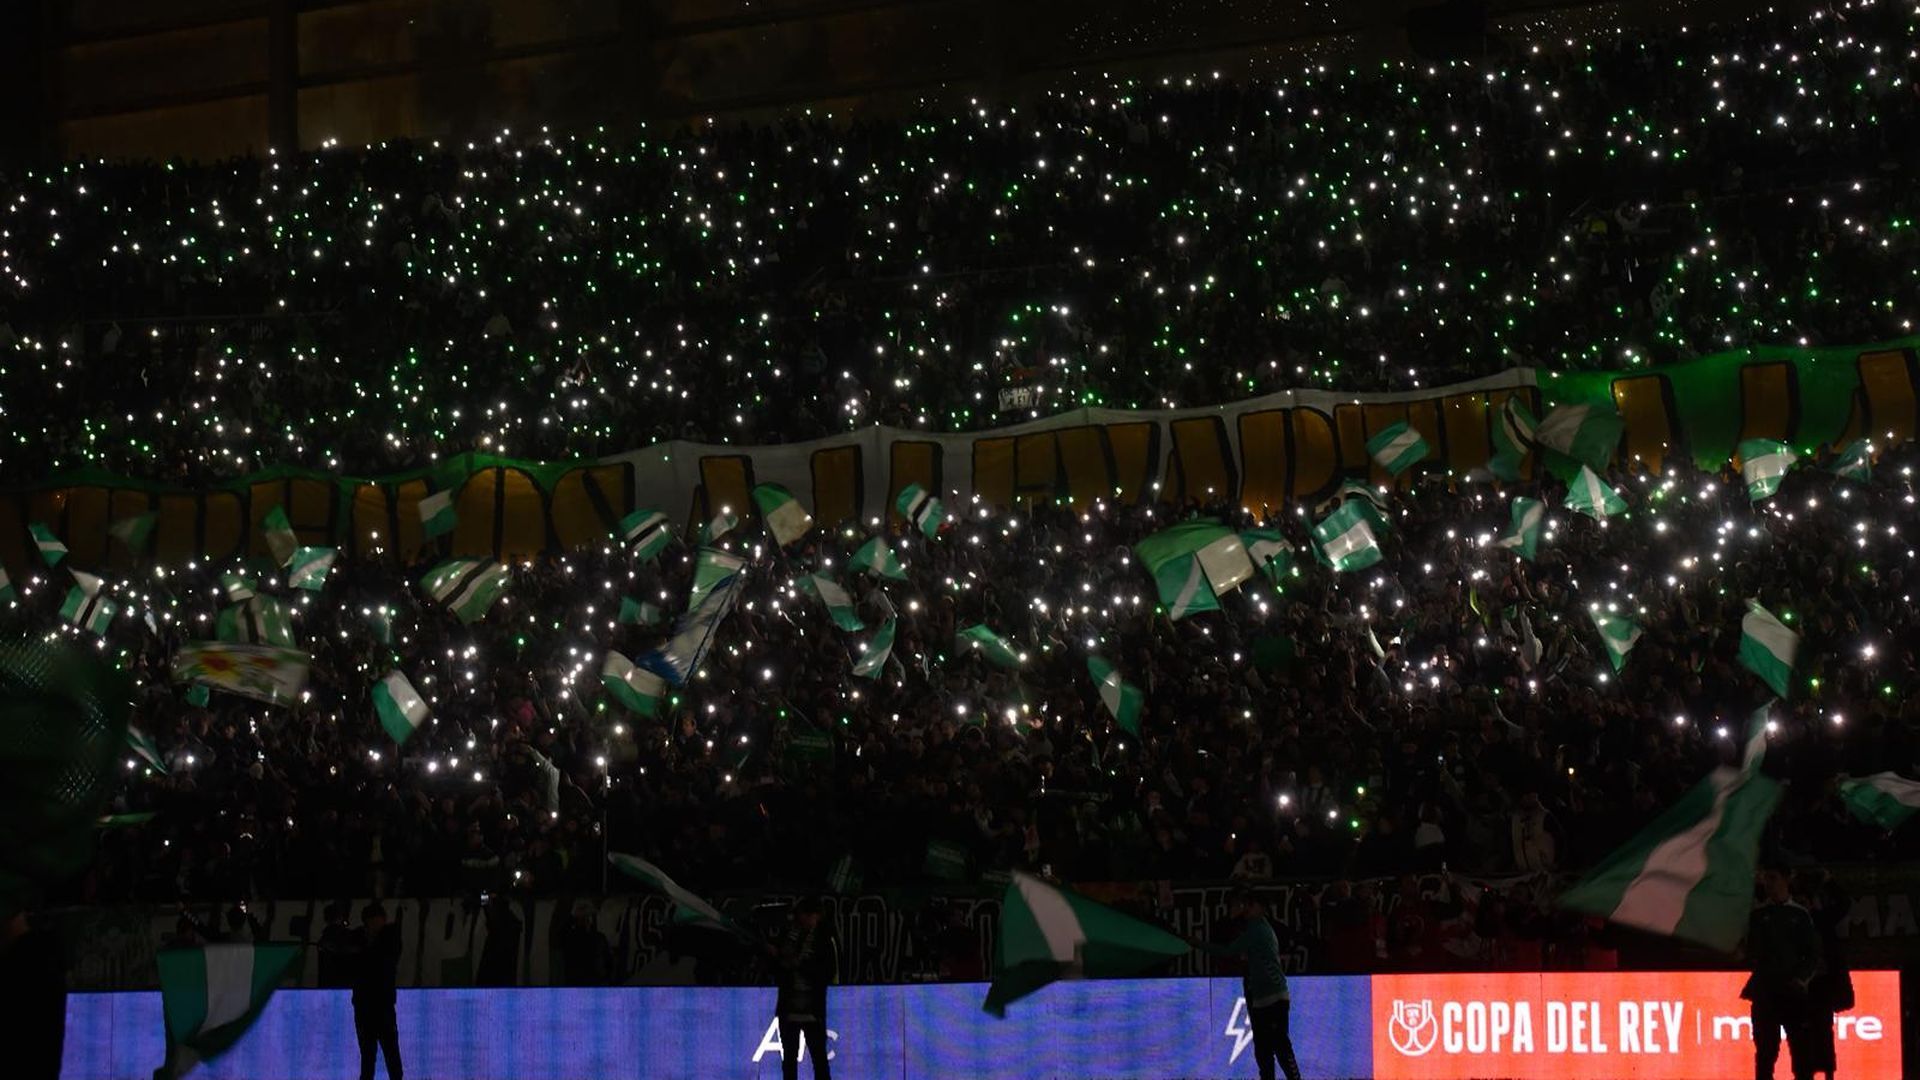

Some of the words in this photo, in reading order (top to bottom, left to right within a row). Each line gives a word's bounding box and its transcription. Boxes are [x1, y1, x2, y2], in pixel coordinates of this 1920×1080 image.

[1442, 1001, 1534, 1053] COPA
[1547, 1001, 1607, 1053] DEL
[1619, 1001, 1684, 1053] REY
[1712, 1014, 1883, 1041] mre
